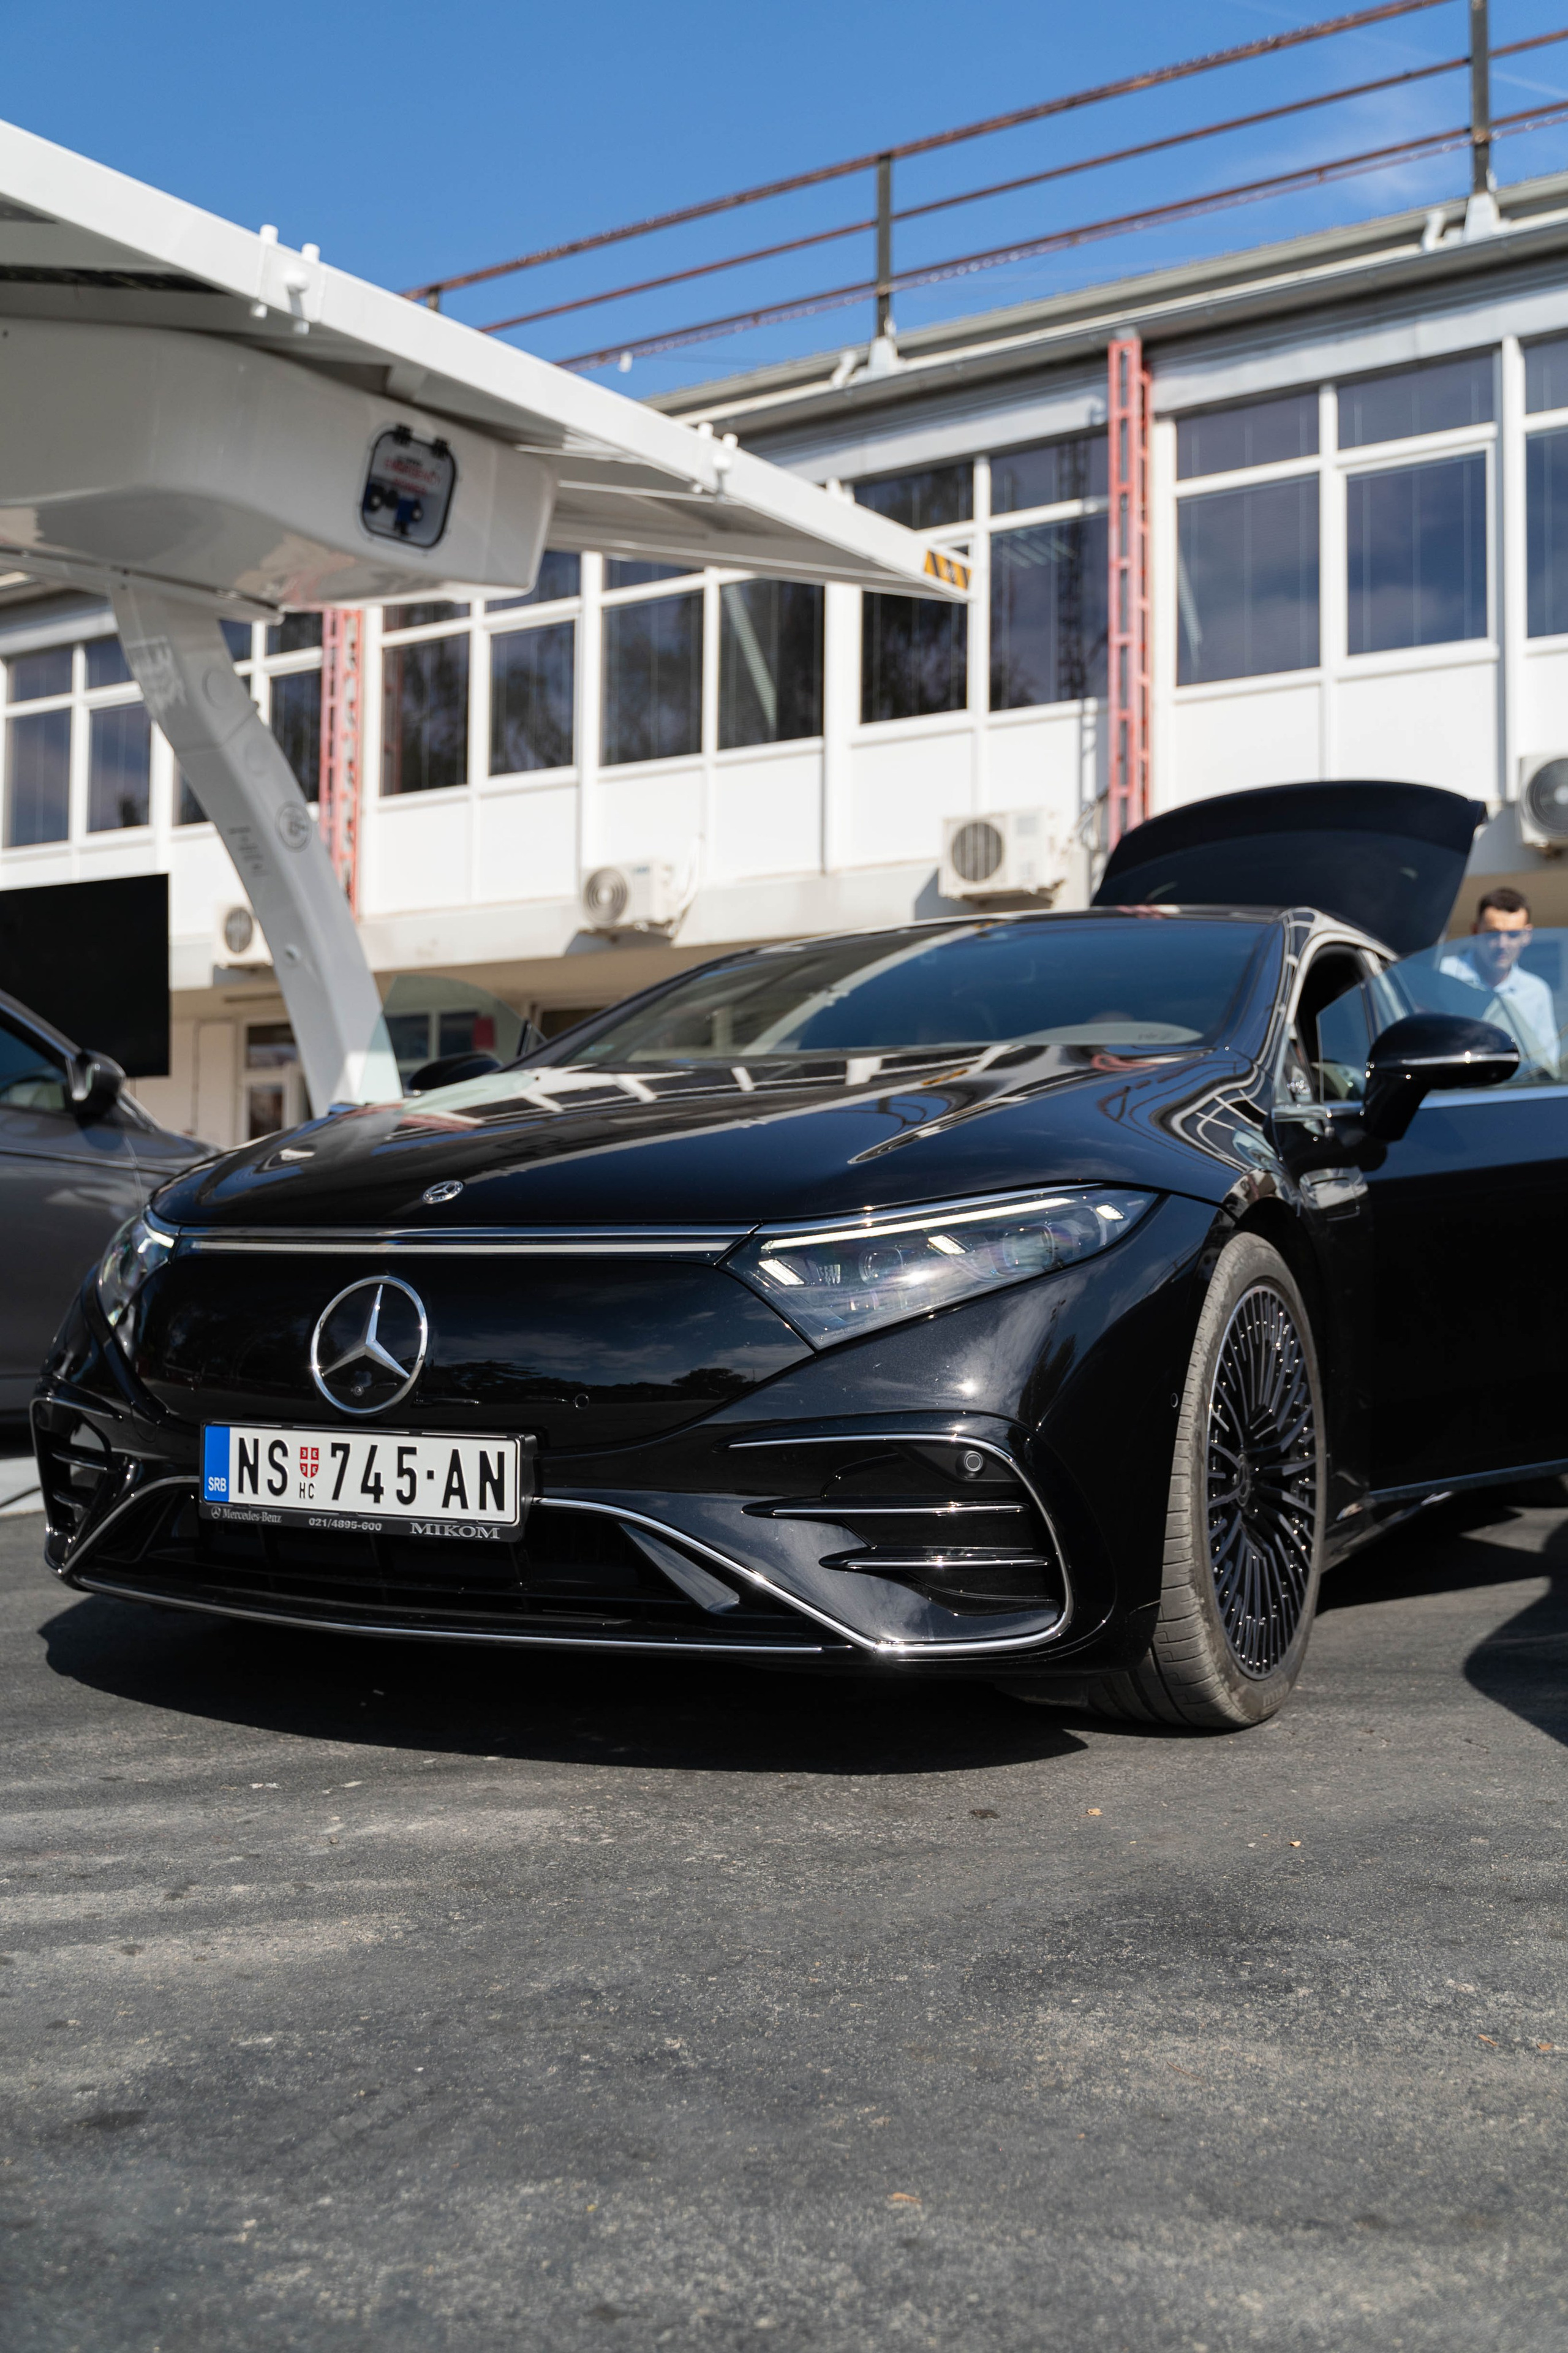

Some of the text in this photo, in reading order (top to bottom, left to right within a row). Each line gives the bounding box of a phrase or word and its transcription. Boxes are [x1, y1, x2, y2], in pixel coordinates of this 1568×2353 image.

[238, 1437, 288, 1496] NS
[208, 1476, 227, 1492] SRB
[222, 1509, 282, 1524] Mercedes-Benz
[308, 1518, 382, 1532] 021/4895-600
[410, 1522, 500, 1539] MIKOM
